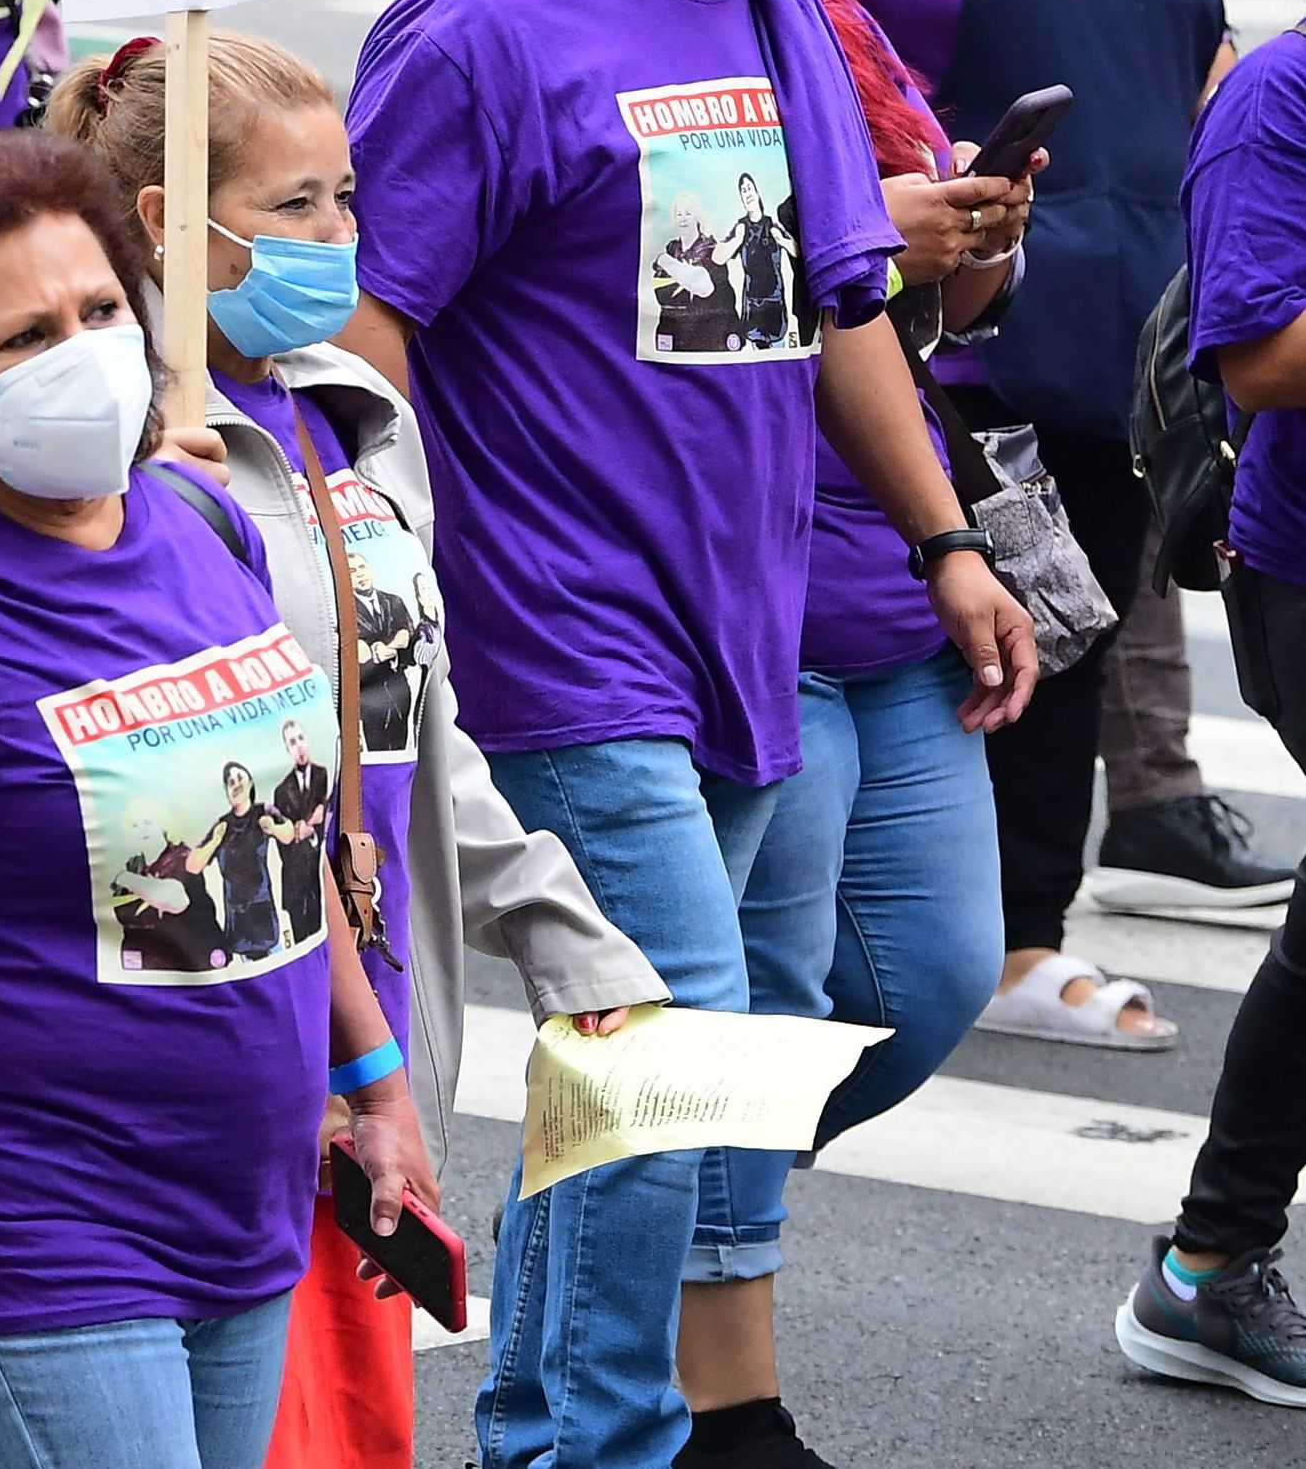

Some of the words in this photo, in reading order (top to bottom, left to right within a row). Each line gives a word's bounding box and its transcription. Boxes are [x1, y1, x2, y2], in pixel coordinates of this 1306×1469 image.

[633, 93, 739, 134] HOMBRO
[741, 92, 759, 124] A
[679, 132, 713, 151] POR
[714, 130, 746, 149] UNA
[747, 128, 783, 148] VIDA
[62, 678, 206, 742] HOMBRO
[204, 669, 235, 704] A
[127, 724, 176, 753] POR
[178, 712, 222, 740] UNA
[222, 697, 272, 726] VIDA
